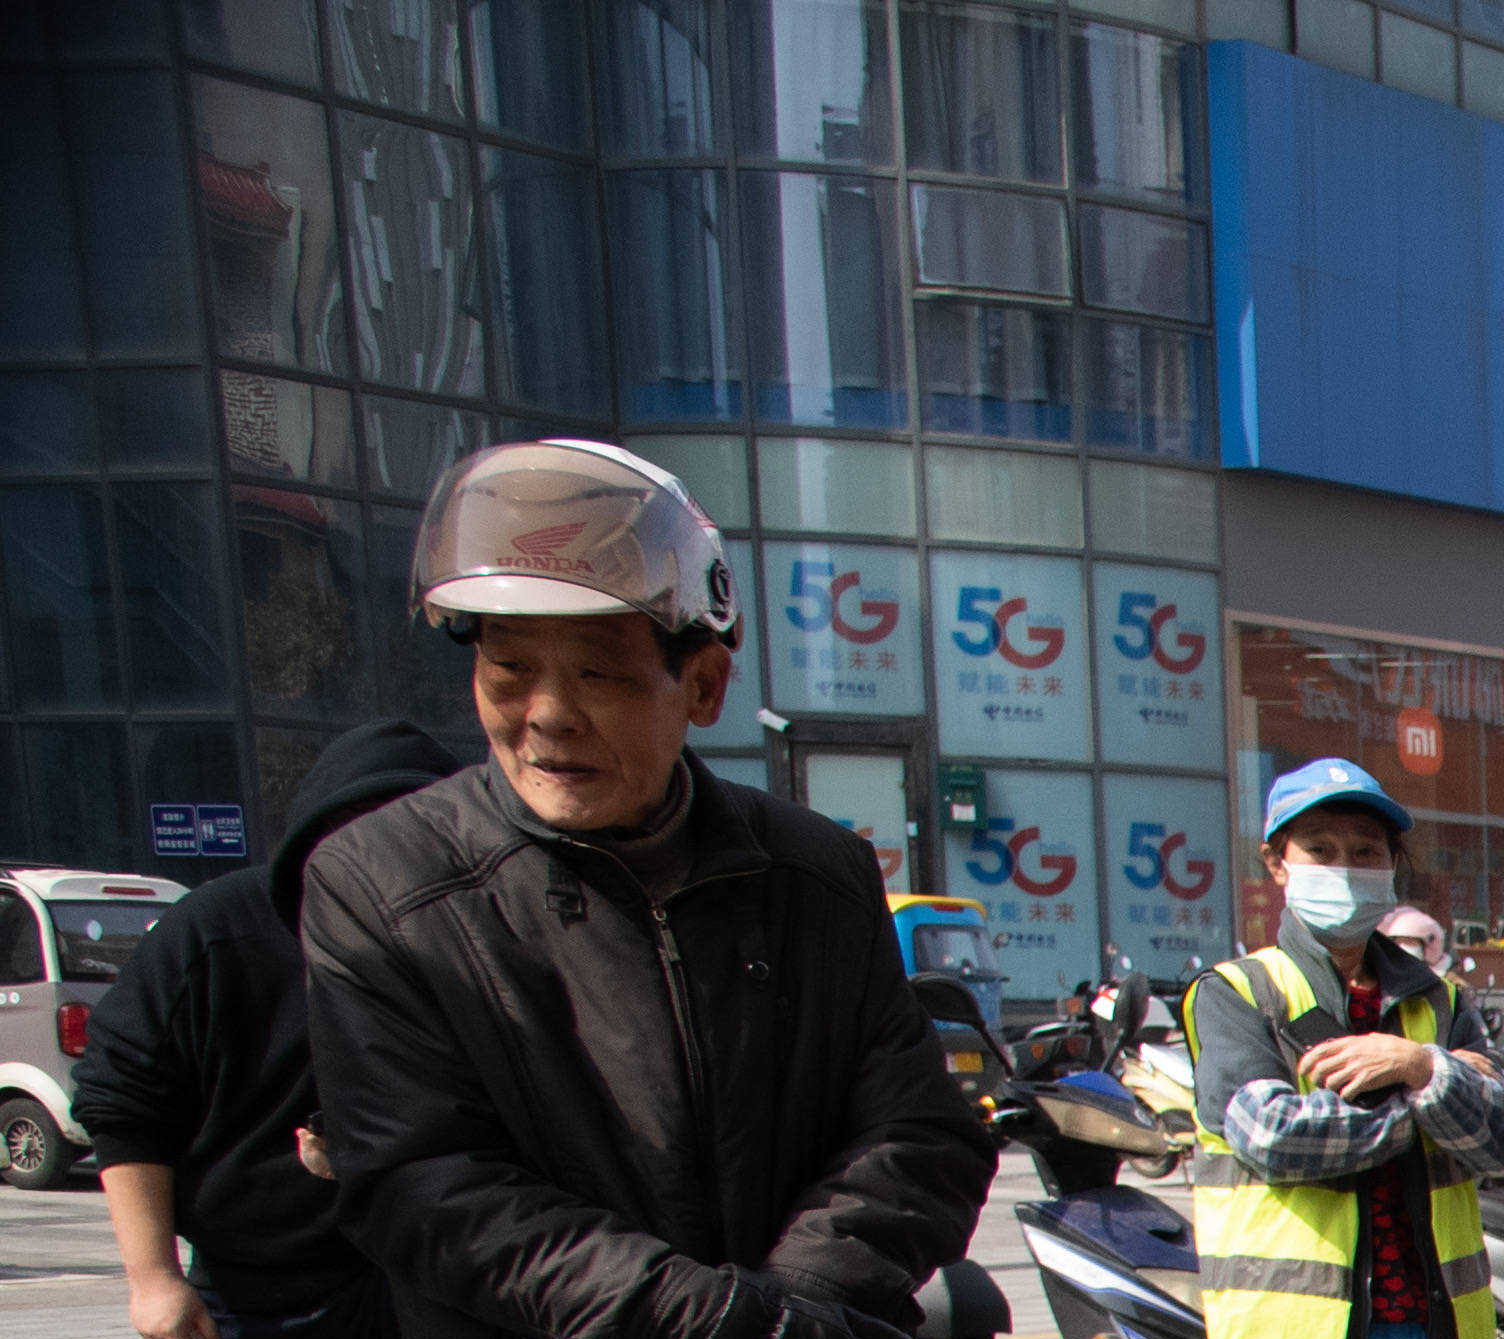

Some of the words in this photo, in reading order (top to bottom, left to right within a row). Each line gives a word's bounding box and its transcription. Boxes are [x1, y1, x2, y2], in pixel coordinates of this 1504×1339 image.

[496, 556, 597, 574] HONDA
[785, 561, 900, 645] 5G
[951, 586, 1065, 670] 5G
[1113, 591, 1207, 675] 5G
[790, 648, 898, 672] 赋能未来
[957, 671, 1065, 697] 赋能未来
[1117, 672, 1206, 699] 赋能未来
[965, 817, 1078, 897] 5G
[1122, 822, 1216, 901] 5G
[1127, 903, 1215, 925] 赋能未来
